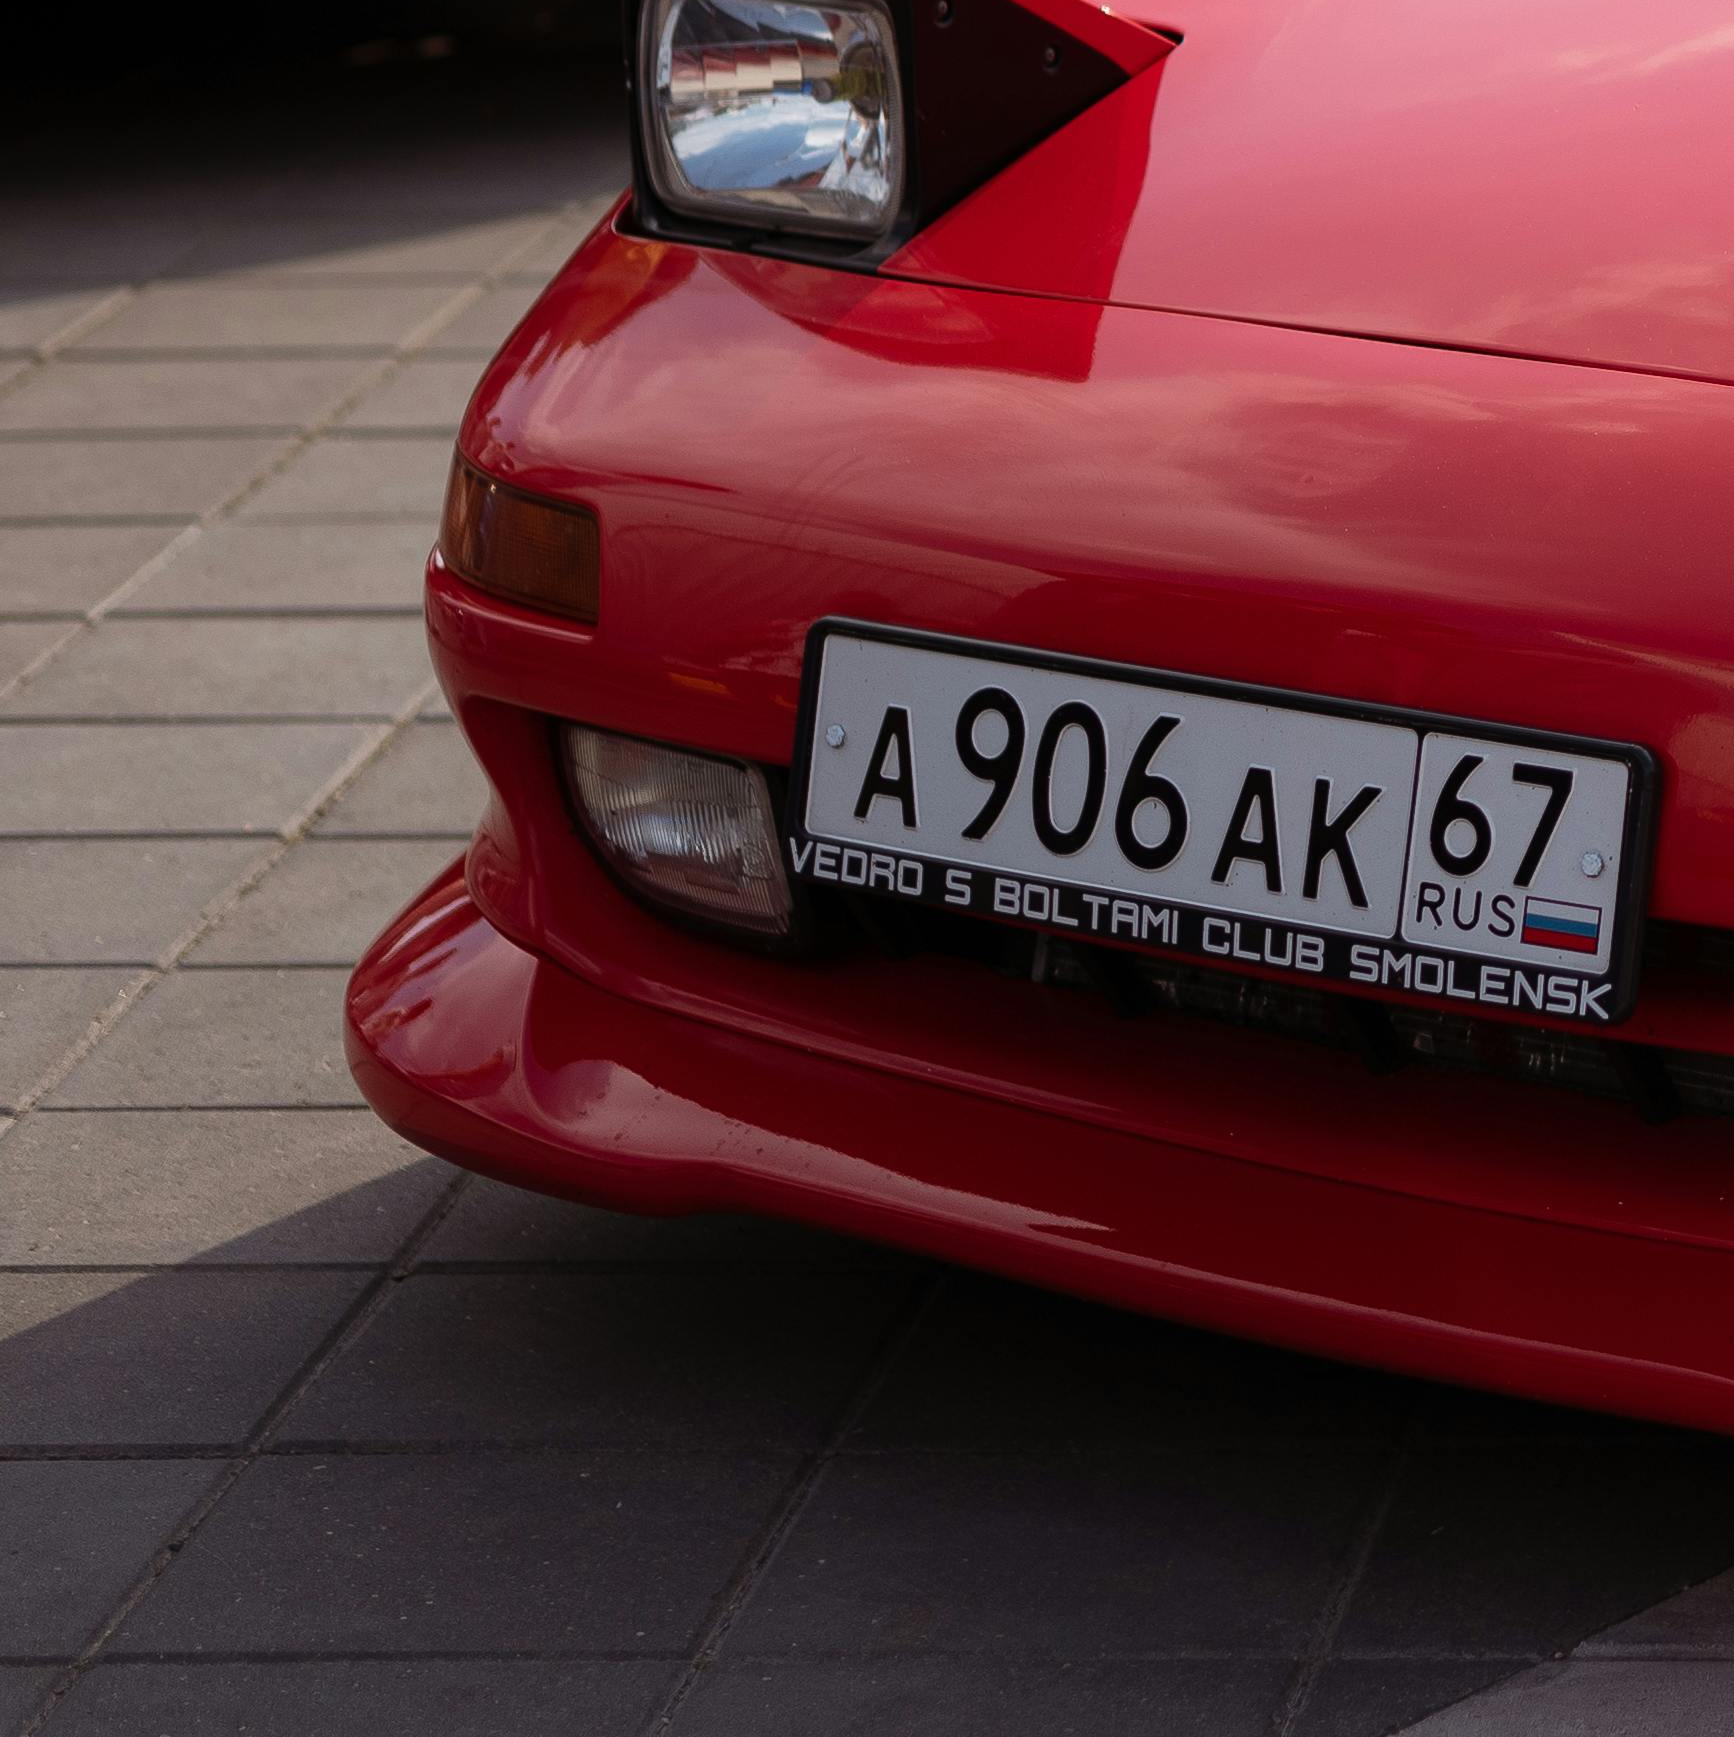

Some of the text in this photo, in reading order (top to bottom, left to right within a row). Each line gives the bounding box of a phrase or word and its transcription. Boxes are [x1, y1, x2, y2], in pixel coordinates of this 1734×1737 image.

[1429, 754, 1575, 888] 67
[788, 836, 924, 896] VEDRO
[944, 868, 972, 906] S
[993, 877, 1180, 945] BOLTAMI
[1202, 916, 1325, 972] CLUB
[1349, 944, 1613, 1020] SMOLENSK
[1415, 881, 1517, 938] RUS
